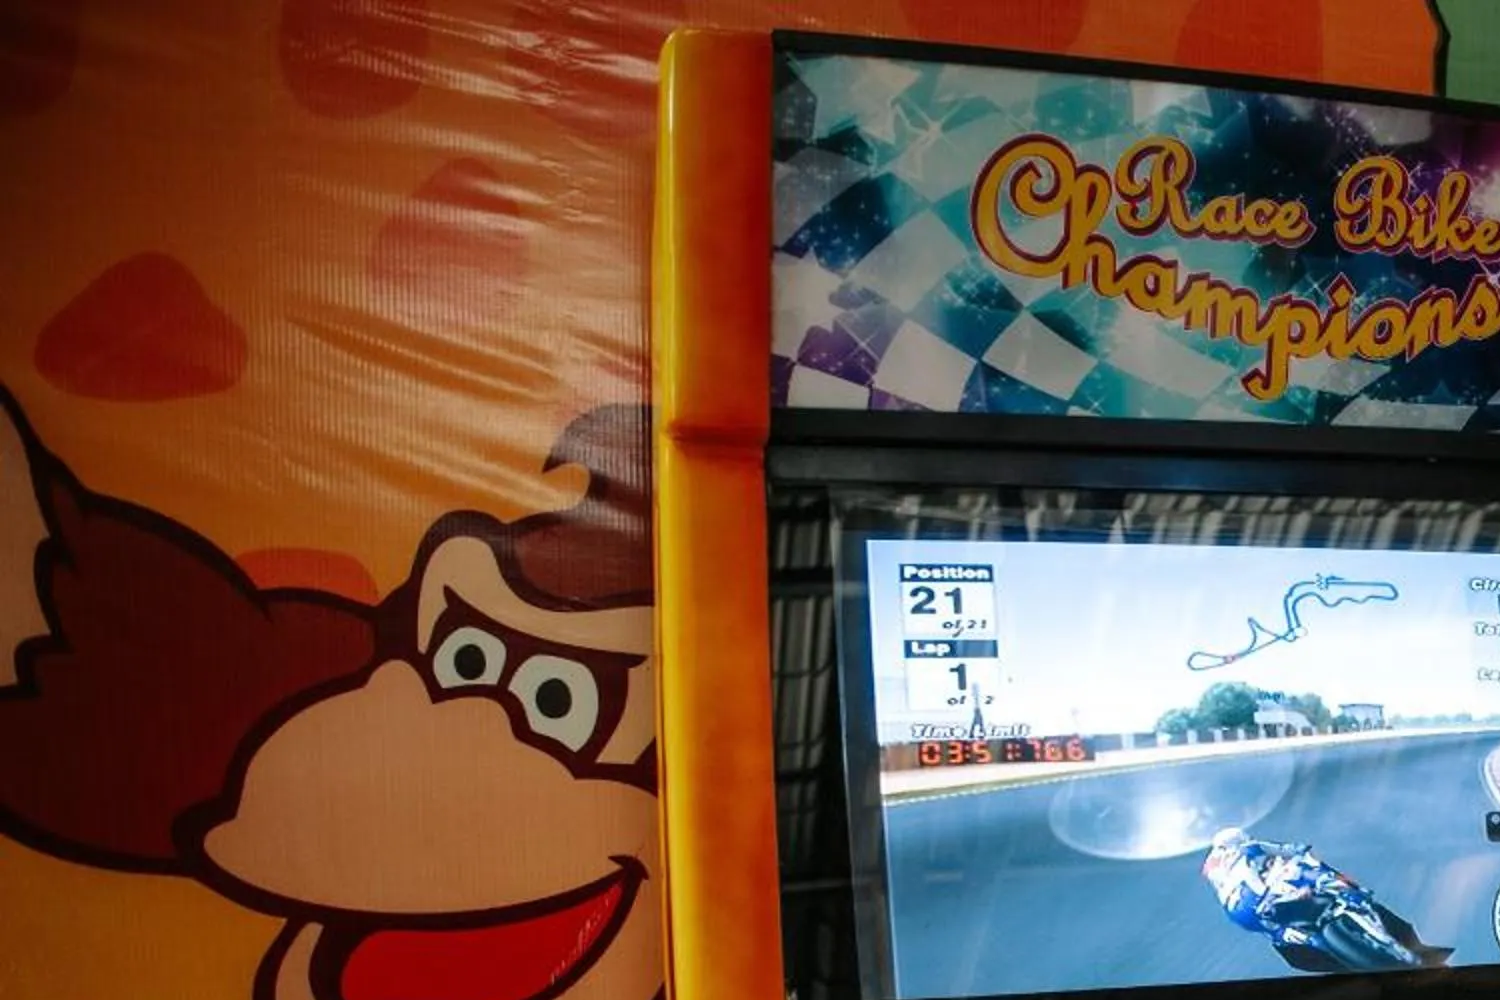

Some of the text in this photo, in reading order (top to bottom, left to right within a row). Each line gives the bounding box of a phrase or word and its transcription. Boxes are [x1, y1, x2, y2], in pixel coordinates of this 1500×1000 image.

[1114, 134, 1315, 245] Race
[902, 565, 991, 581] Position
[909, 586, 963, 615] 21
[910, 641, 951, 657] Lap
[949, 663, 967, 691] 1
[946, 695, 995, 706] of 2
[911, 723, 966, 739] Time
